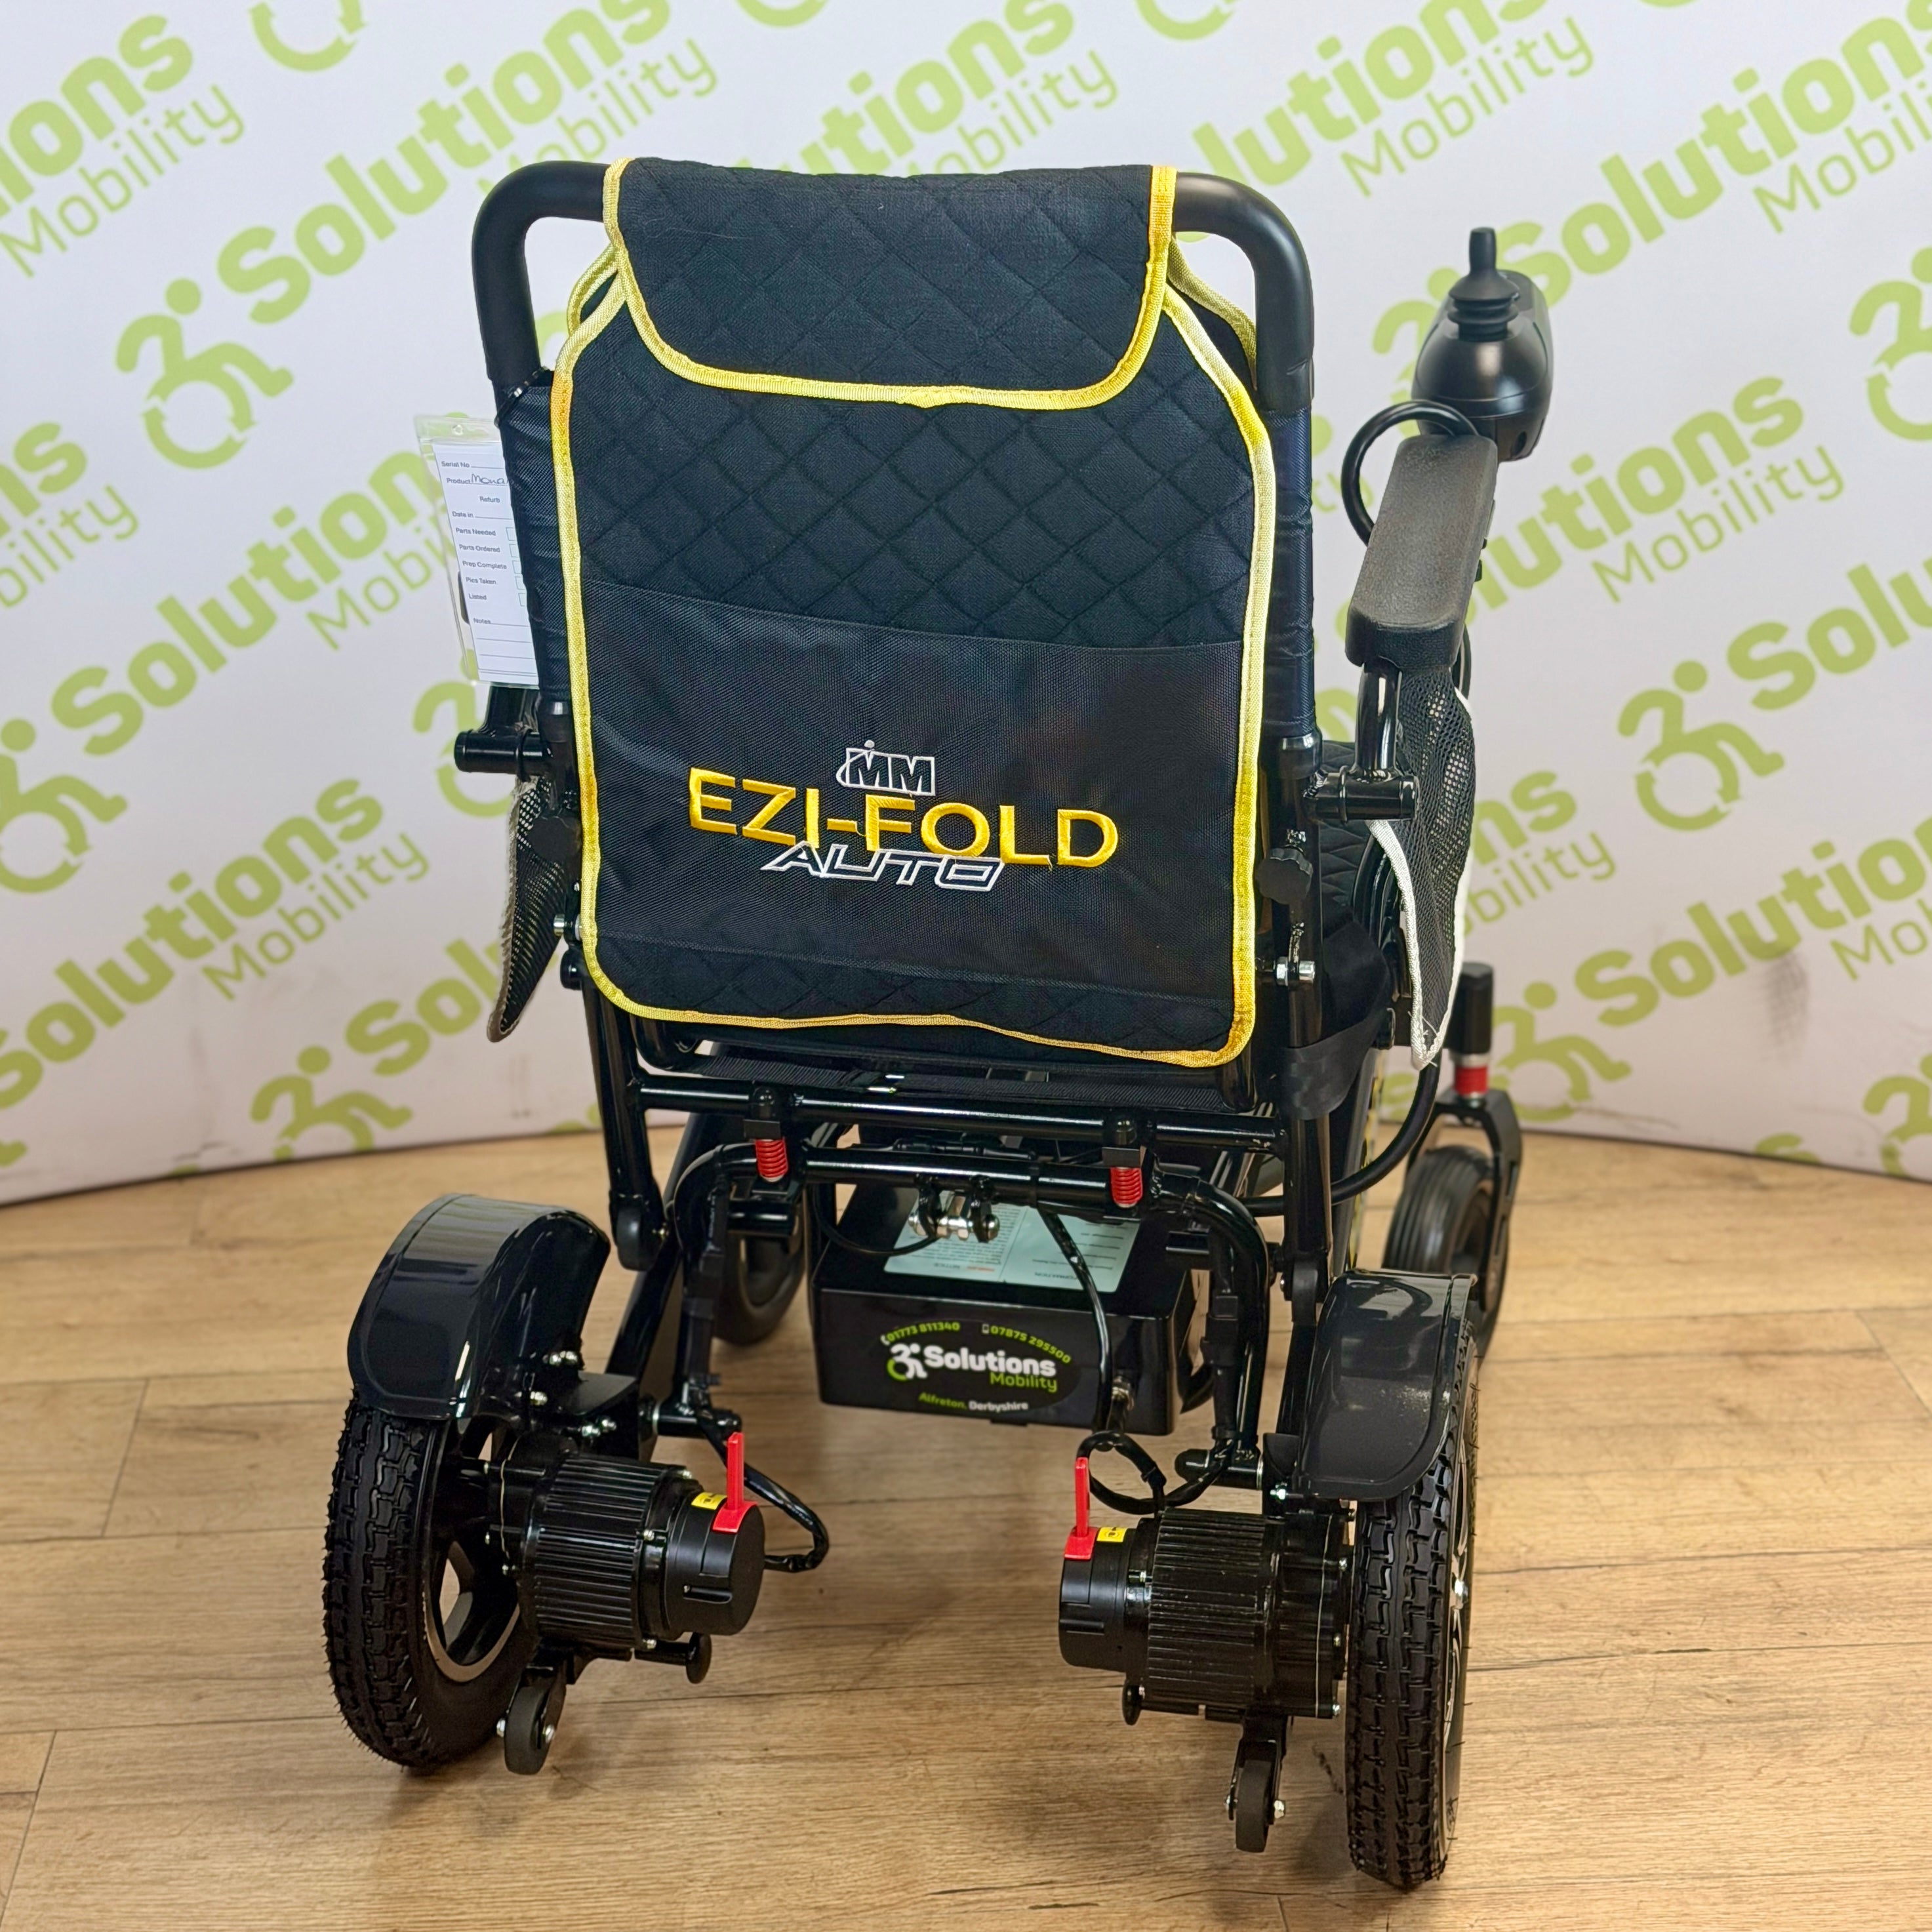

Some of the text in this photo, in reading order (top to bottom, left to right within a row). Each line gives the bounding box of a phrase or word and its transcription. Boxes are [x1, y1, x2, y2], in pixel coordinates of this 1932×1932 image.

[216, 0, 670, 325] Solutions
[1340, 17, 1594, 197] Mobility
[1752, 80, 1932, 233] Mobil
[0, 84, 245, 278] Mobility
[471, 473, 510, 485] Mona
[1590, 444, 1845, 604] Mobility
[50, 450, 445, 757] Solution
[689, 767, 1119, 868] EZI-FOLD
[761, 841, 1005, 892] AUTO
[201, 833, 430, 1002] Mobility
[1573, 816, 1932, 1028] Solutio
[887, 1321, 961, 1342] 01773 811340
[923, 1345, 1057, 1377] Solutions
[990, 1325, 1028, 1342] 07875
[990, 1371, 1058, 1394] Mobility
[968, 1400, 1029, 1413] Derbyshire
